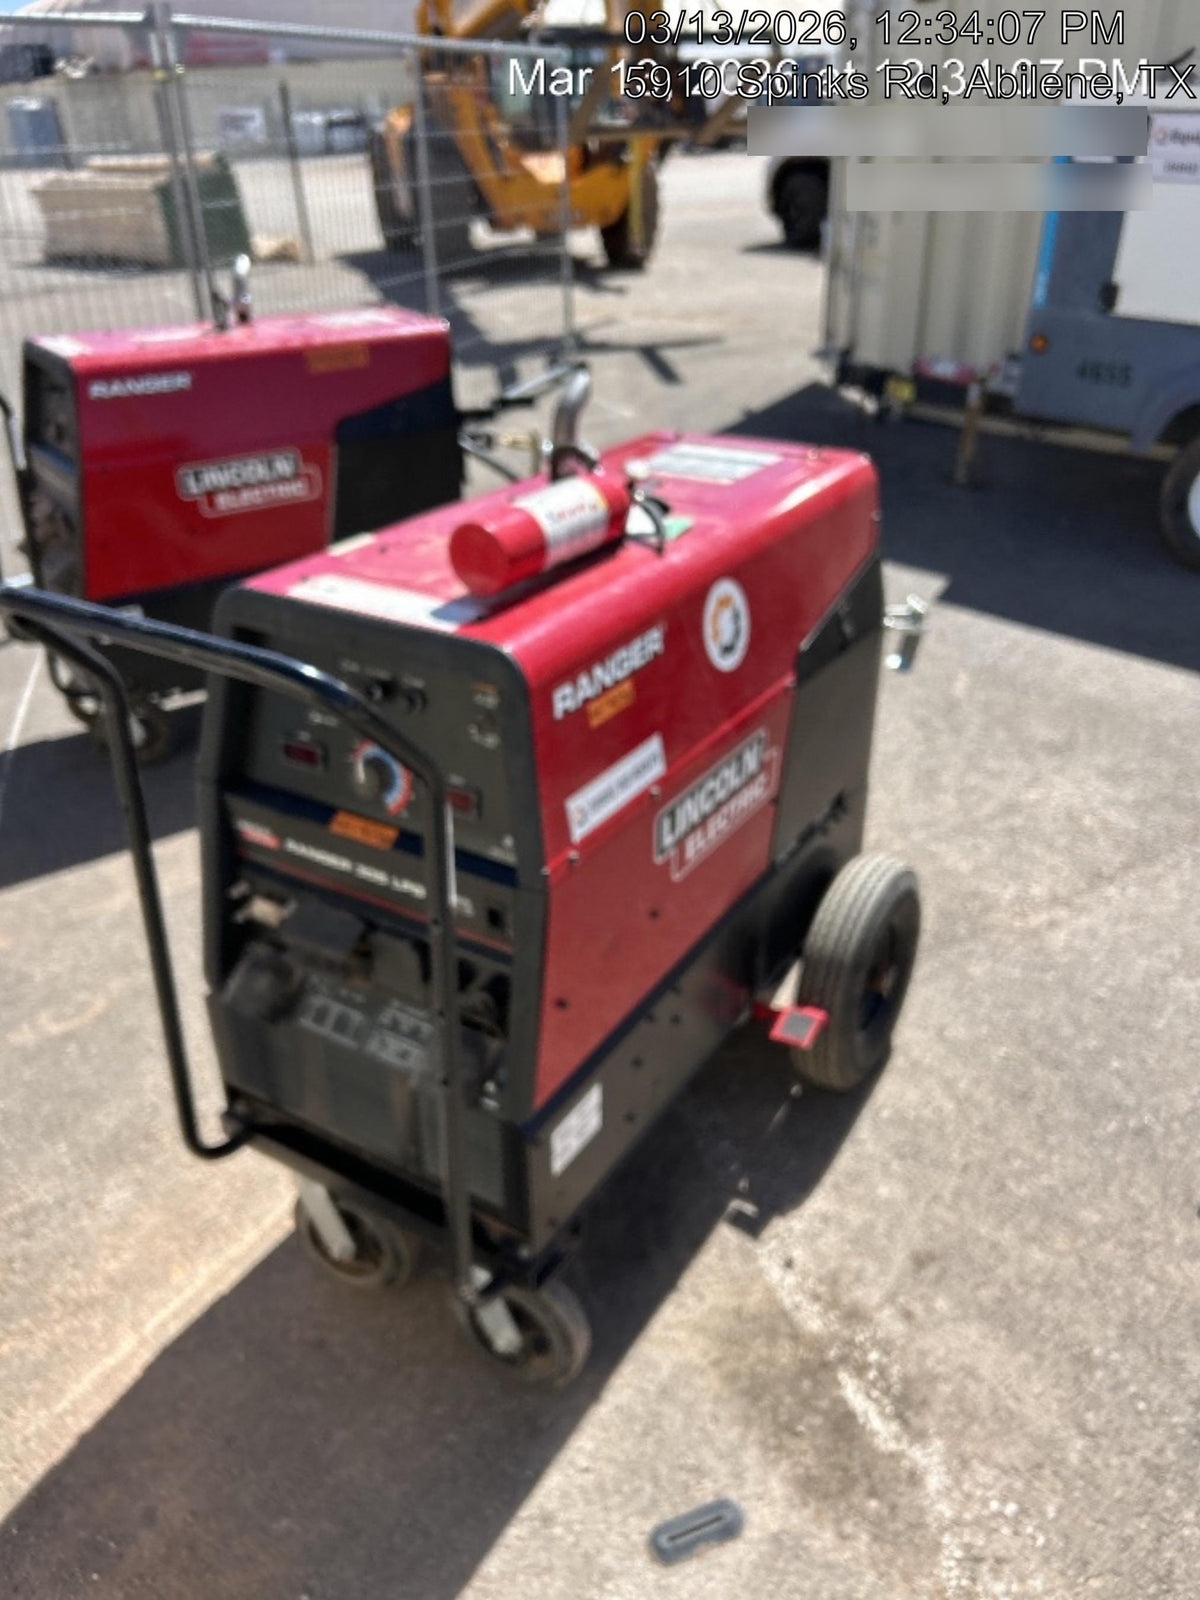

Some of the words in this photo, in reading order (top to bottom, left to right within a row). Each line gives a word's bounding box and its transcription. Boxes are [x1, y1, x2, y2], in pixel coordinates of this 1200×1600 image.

[89, 372, 192, 399] RANGER
[182, 452, 297, 494] LINCOLN
[214, 475, 308, 511] ELECTRIC
[551, 622, 666, 720] RANGER
[658, 730, 768, 854] LINCOLN
[683, 772, 769, 862] ELECTRIC
